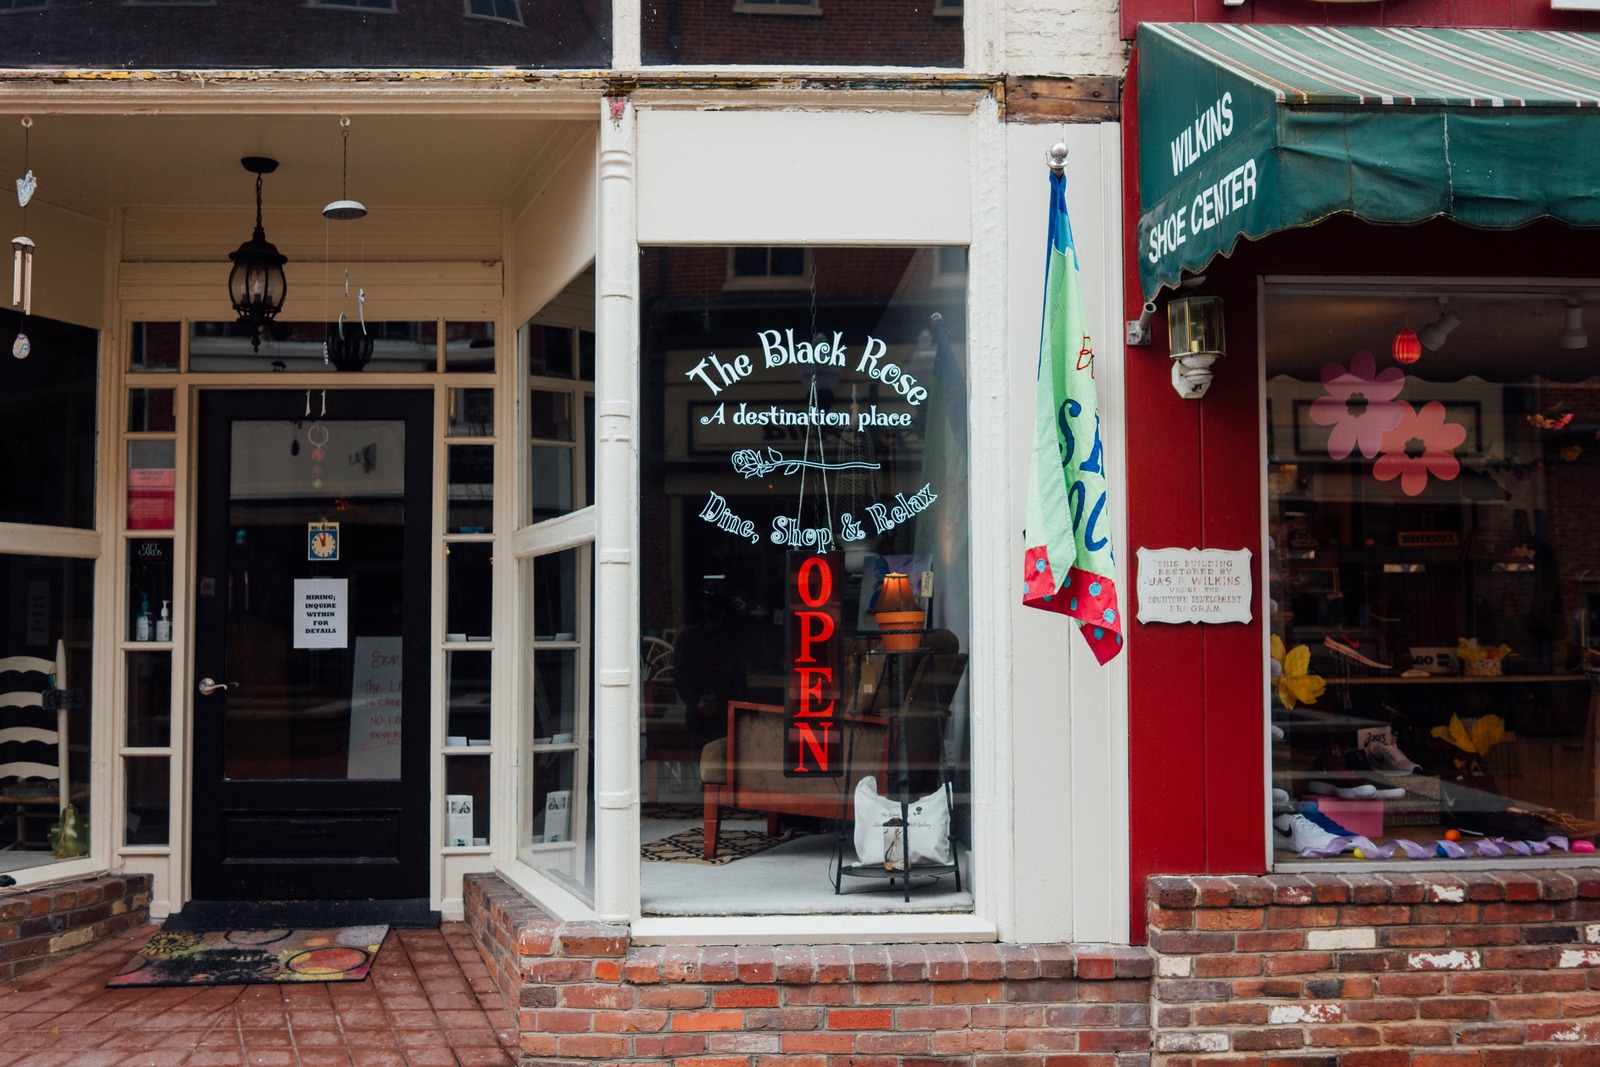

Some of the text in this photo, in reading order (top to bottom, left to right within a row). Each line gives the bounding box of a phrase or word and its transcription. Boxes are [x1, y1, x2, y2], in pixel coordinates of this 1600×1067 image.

[1170, 92, 1234, 176] WILKINS
[1148, 158, 1257, 263] SHOE CENTER
[684, 328, 928, 406] The Black Rose
[700, 402, 912, 432] A destination place
[698, 482, 938, 554] Dine, Shop & Relax
[1192, 576, 1241, 585] WILKINS
[793, 557, 835, 773] OPEN
